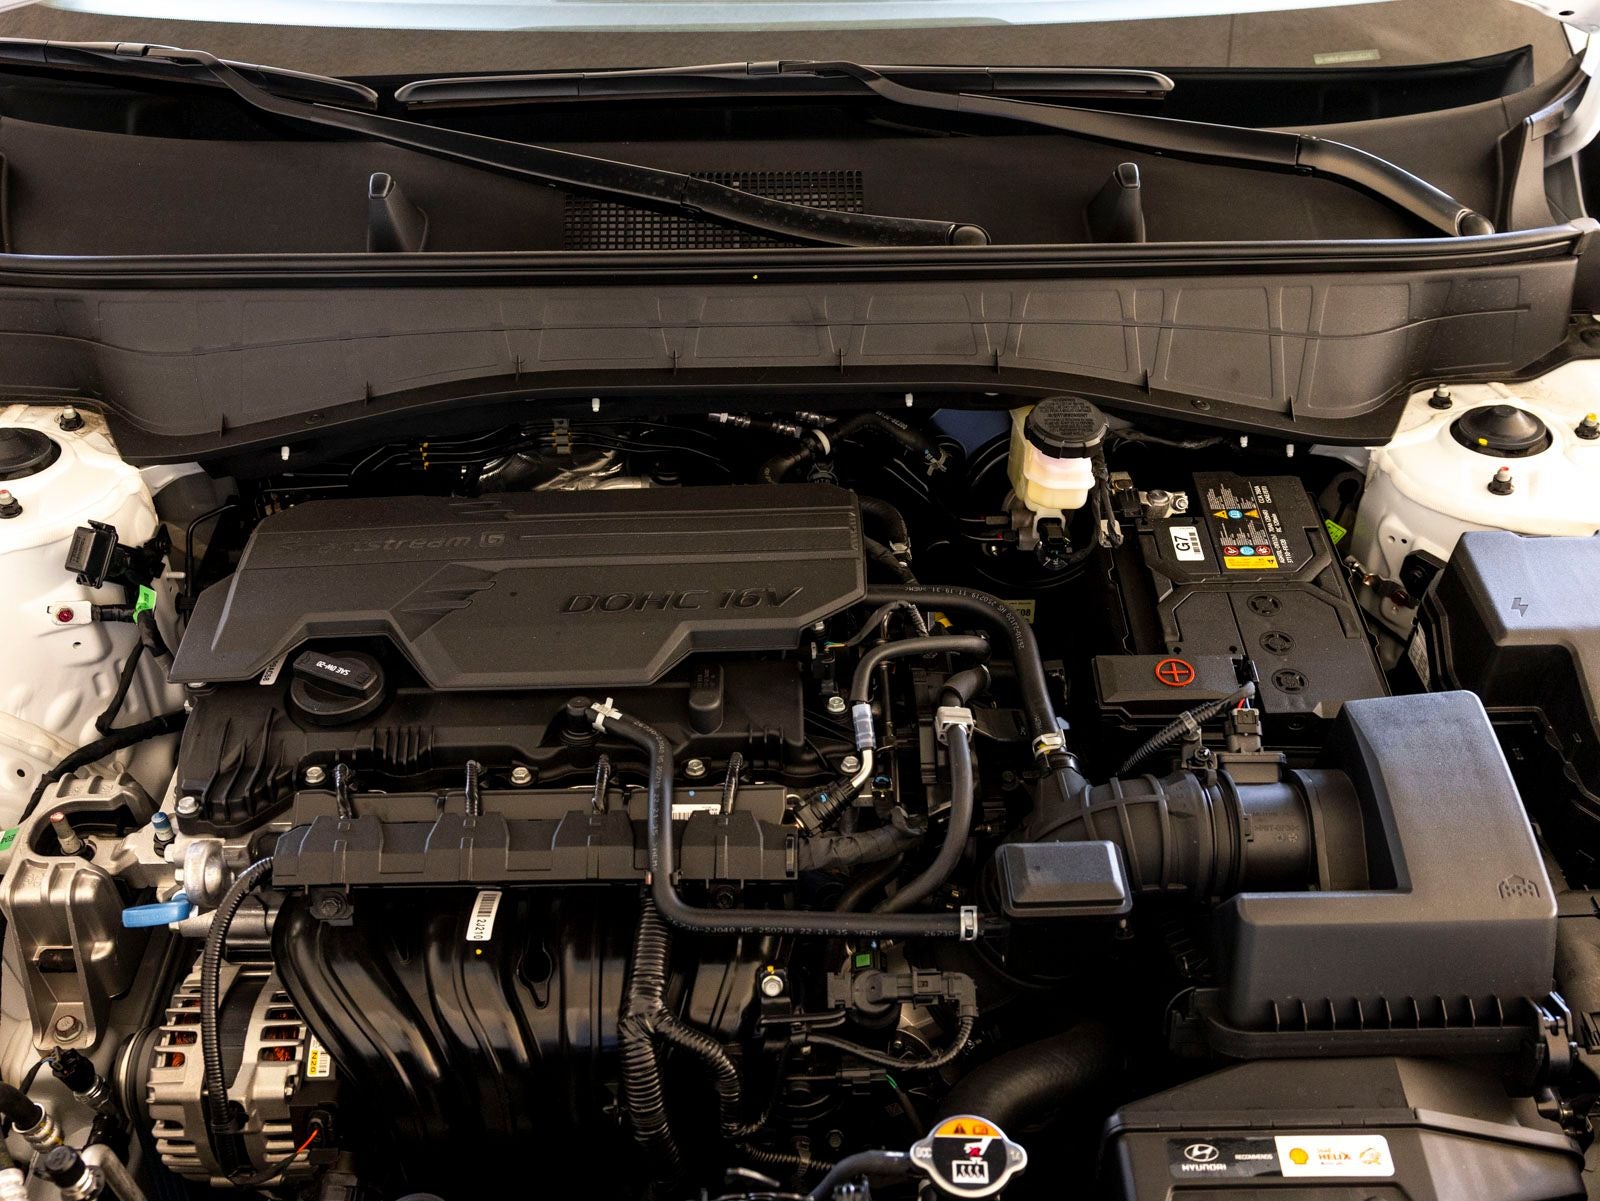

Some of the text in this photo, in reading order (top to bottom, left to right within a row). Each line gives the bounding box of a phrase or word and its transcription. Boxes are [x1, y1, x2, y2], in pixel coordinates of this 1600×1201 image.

[1173, 535, 1191, 551] G7
[560, 586, 805, 615] DOHC 16V
[315, 660, 351, 676] SAE 0W-20
[473, 919, 487, 940] 2J210
[310, 1052, 318, 1073] N20
[1182, 1163, 1227, 1172] HYUNDAI
